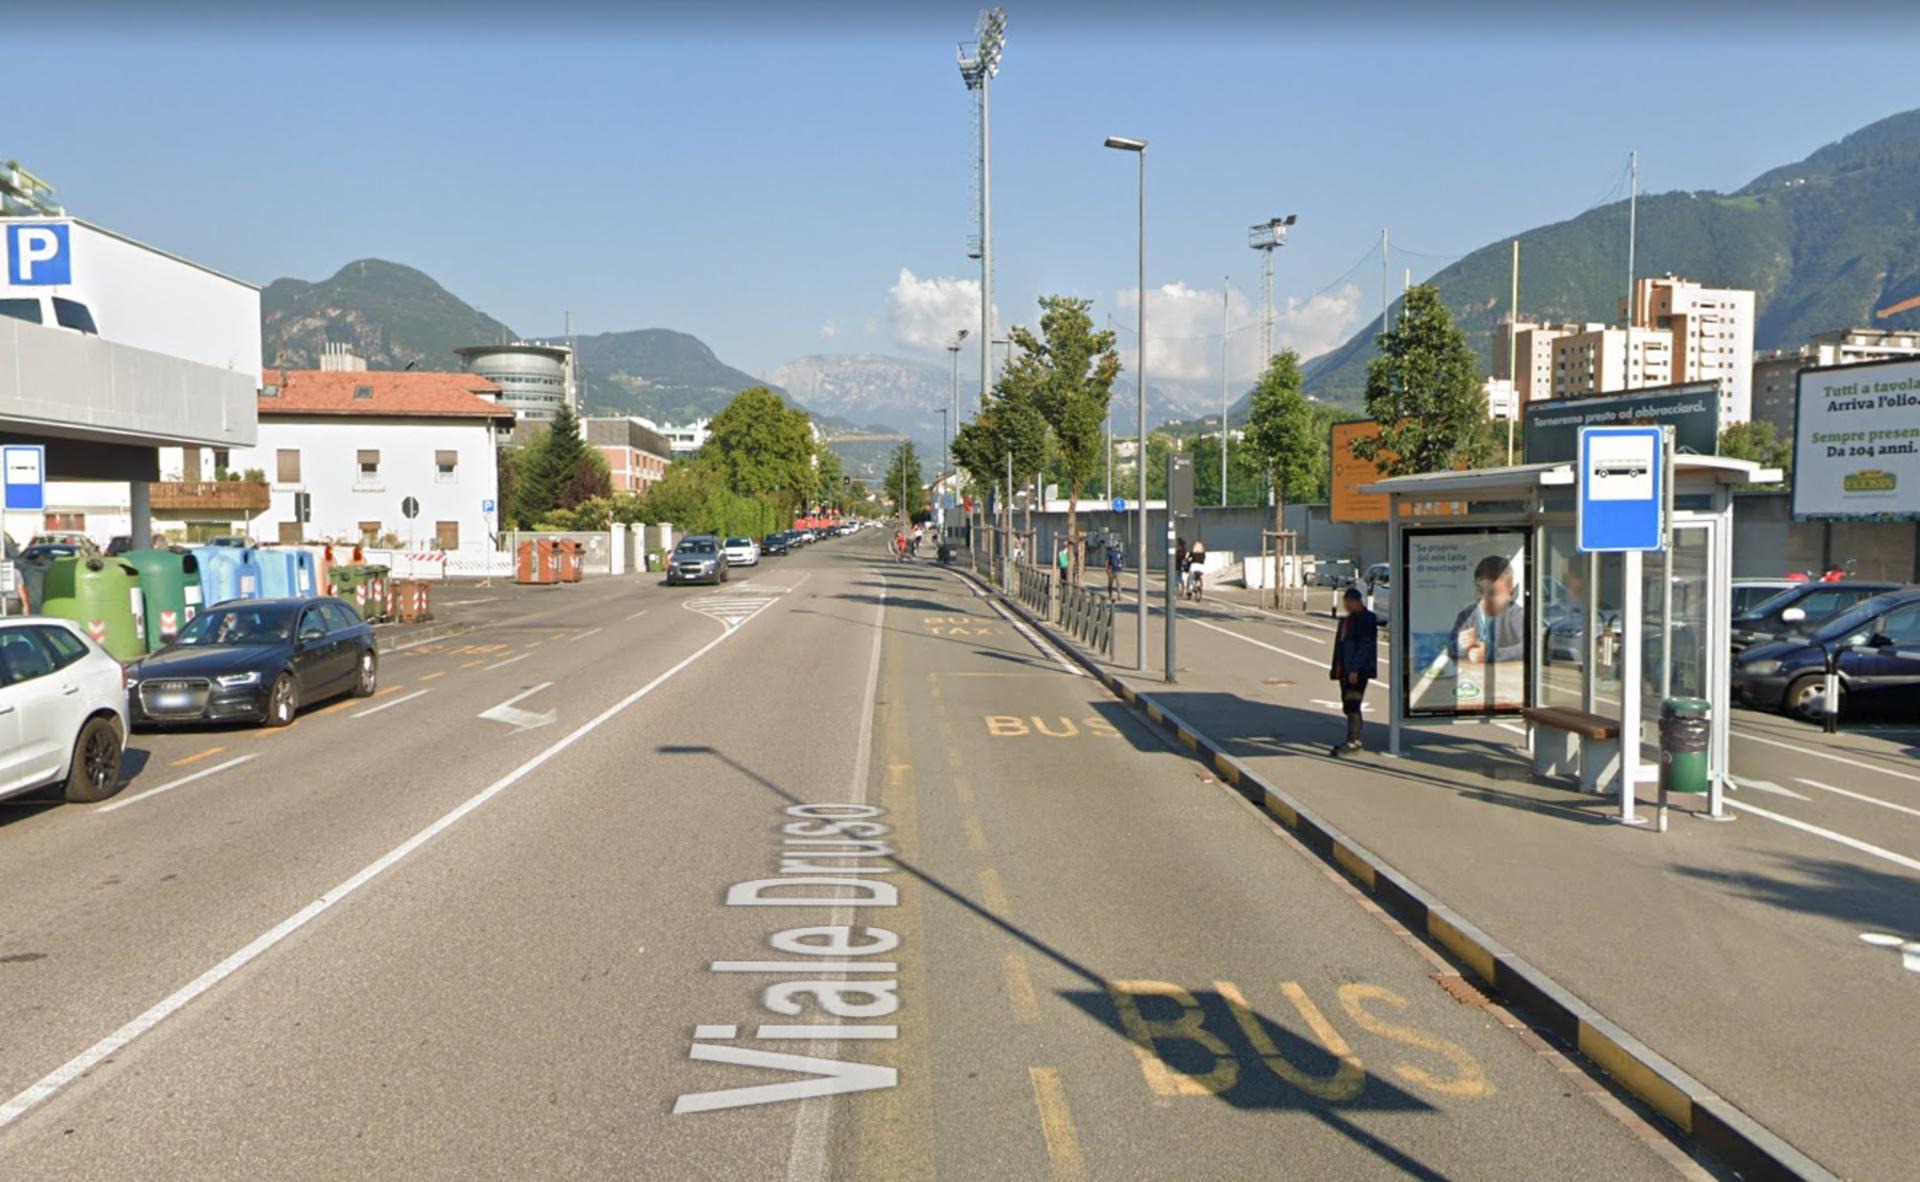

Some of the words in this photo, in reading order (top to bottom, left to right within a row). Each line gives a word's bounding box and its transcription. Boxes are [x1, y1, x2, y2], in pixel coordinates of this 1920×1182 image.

[17, 227, 59, 280] P
[1823, 383, 1858, 397] Tutti
[1861, 385, 1870, 394] a
[1874, 377, 1920, 393] tavola
[1533, 417, 1583, 428] Torneremo
[1585, 412, 1616, 425] presto
[1618, 407, 1633, 420] ad
[1635, 401, 1706, 418] abbracciarci.
[1827, 398, 1875, 412] Arriva
[1812, 430, 1865, 445] Sempre
[1868, 427, 1920, 443] presen
[1826, 446, 1846, 458] Da
[1849, 446, 1875, 457] 204
[1878, 441, 1918, 455] anni.
[984, 714, 1124, 737] BUS
[1108, 980, 1496, 1101] BUS
